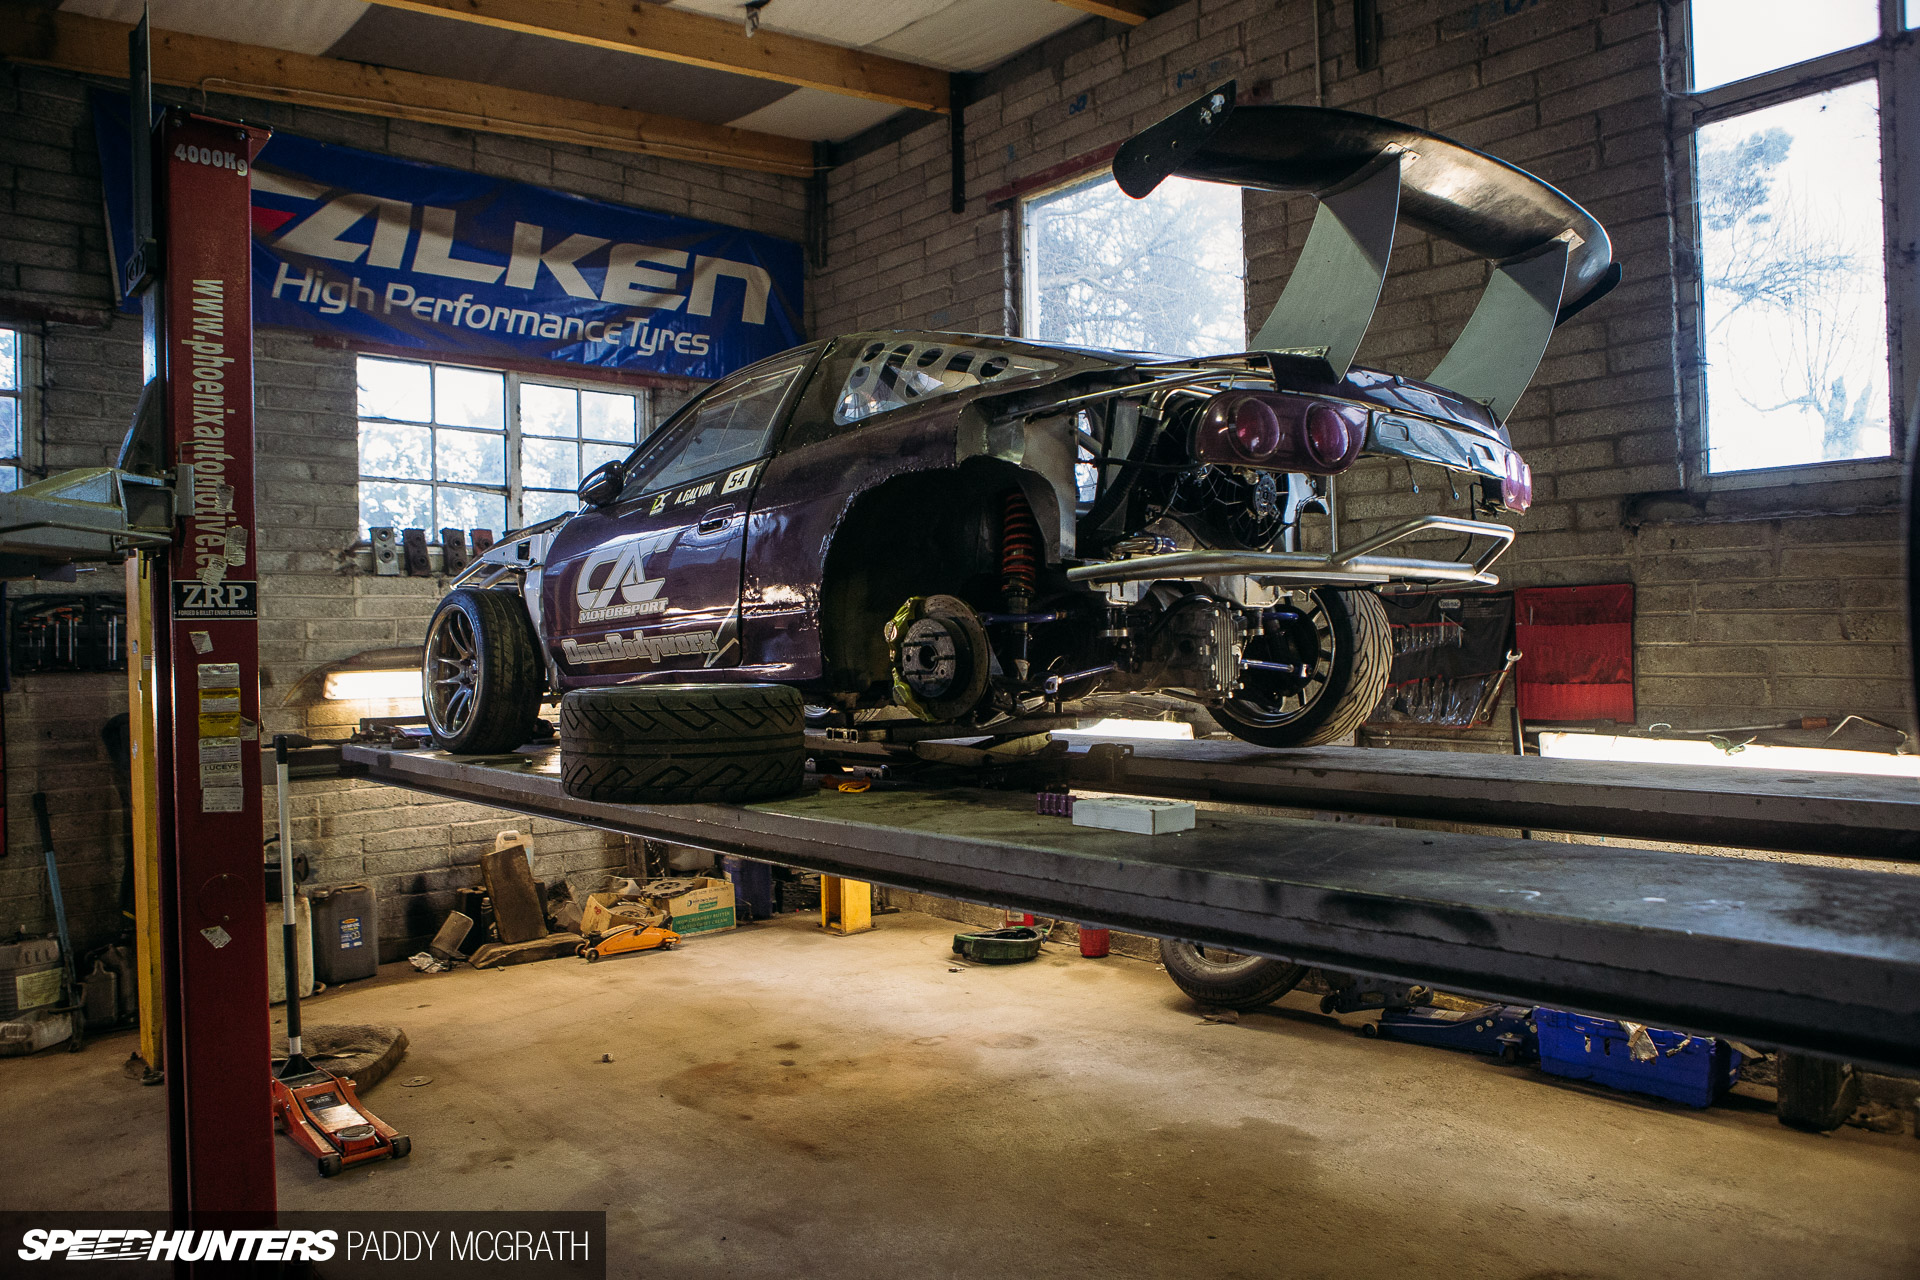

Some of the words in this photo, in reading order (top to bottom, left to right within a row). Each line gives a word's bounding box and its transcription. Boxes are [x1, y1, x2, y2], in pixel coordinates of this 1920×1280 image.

[174, 143, 248, 177] 4000Kg
[271, 262, 375, 315] High
[382, 281, 623, 345] Performance
[625, 316, 710, 357] Tyres
[182, 584, 248, 608] ZRP
[578, 597, 669, 624] MOTORSPORT
